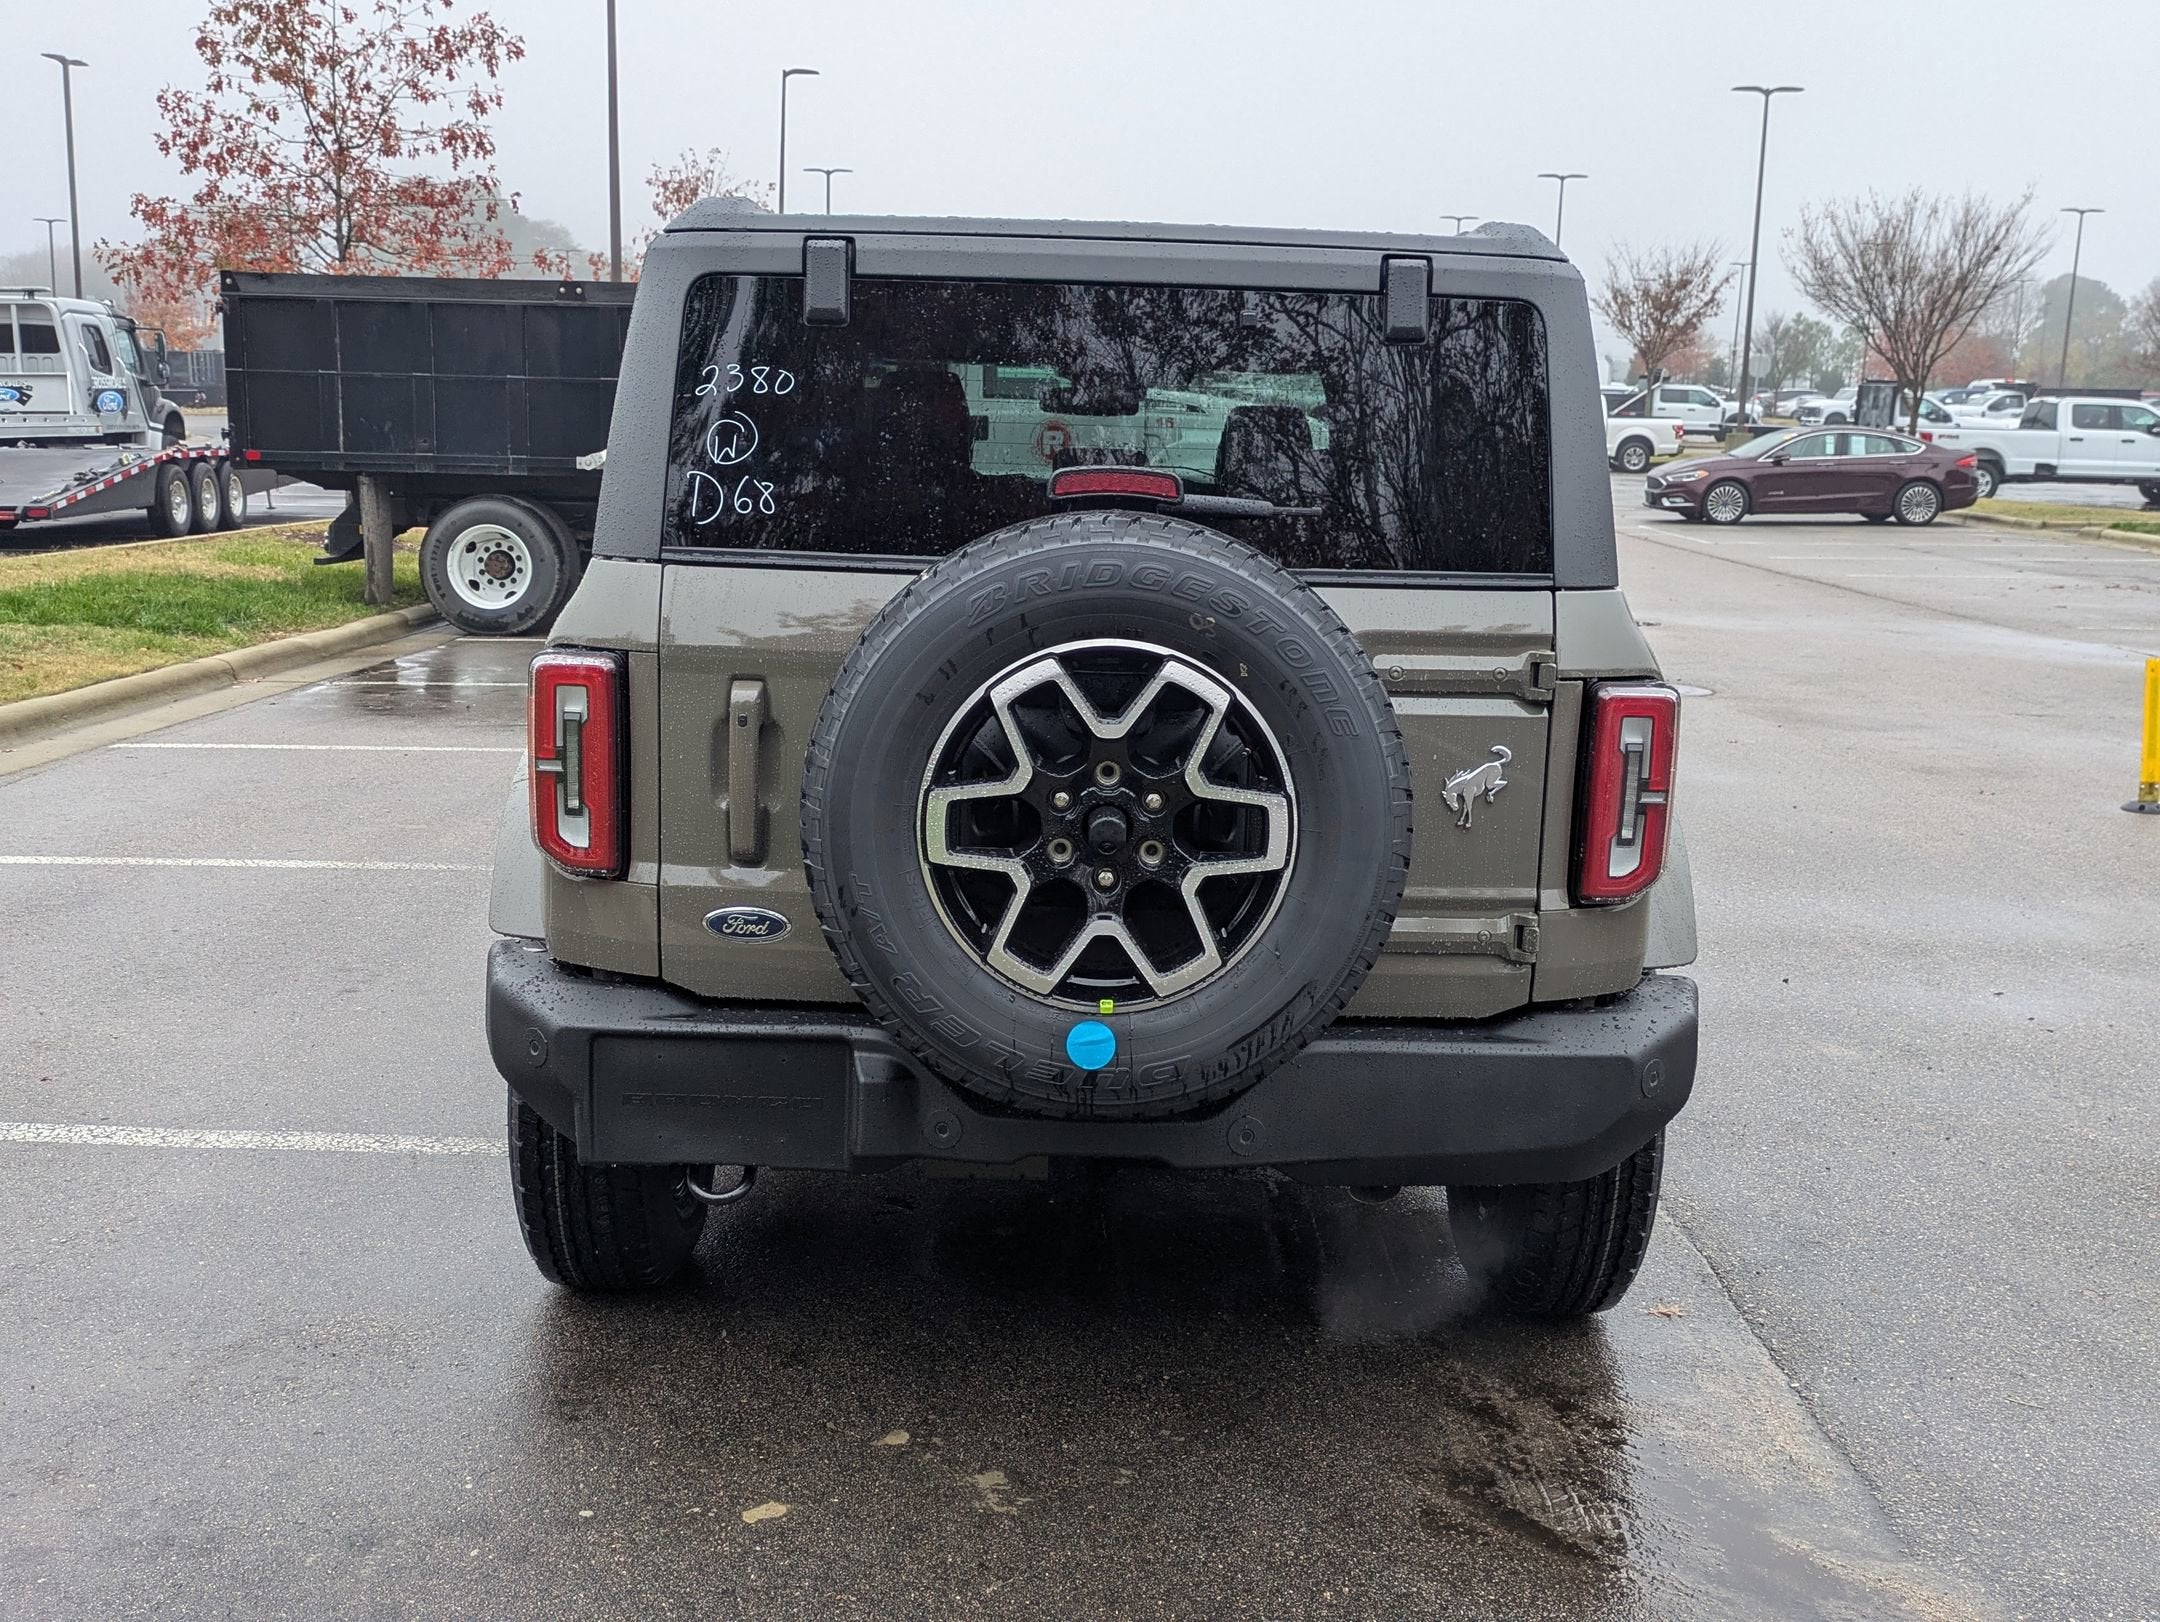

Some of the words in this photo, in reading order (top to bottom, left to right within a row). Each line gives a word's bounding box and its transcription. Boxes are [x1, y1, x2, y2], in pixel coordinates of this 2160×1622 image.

[695, 364, 795, 396] 2380
[687, 470, 775, 524] D68
[966, 559, 1361, 740] BRIDGESTONE
[722, 913, 771, 935] Ford
[890, 970, 1194, 1090] DUELER
